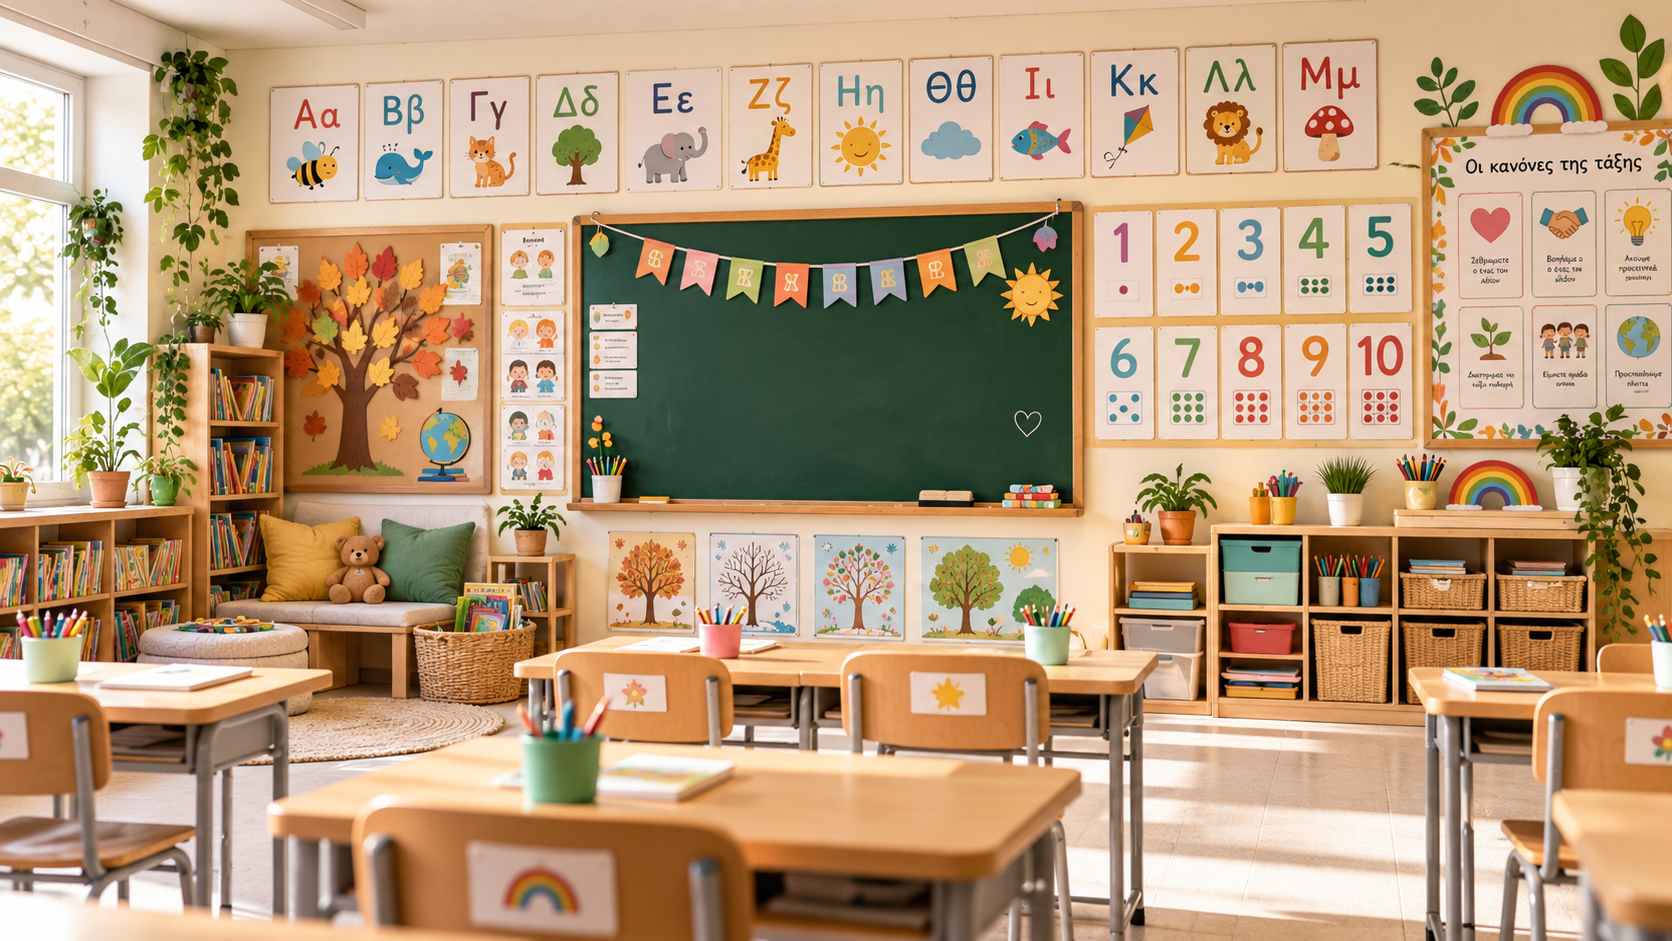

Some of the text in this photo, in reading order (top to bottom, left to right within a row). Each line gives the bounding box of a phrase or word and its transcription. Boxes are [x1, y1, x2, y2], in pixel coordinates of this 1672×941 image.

[838, 75, 884, 113] Ηη
[926, 69, 976, 103] Θθ
[1025, 67, 1055, 99] Ιι
[1111, 64, 1158, 97] Κκ
[1203, 58, 1256, 93] Λλ
[1301, 56, 1360, 100] Μμ
[294, 99, 340, 129] Αα
[384, 94, 424, 134] Ββ
[471, 91, 507, 130] Γγ
[553, 85, 599, 118] Δδ
[653, 83, 693, 114] Εε
[748, 77, 791, 115] Ζζ
[1466, 153, 1642, 175] Οι κανόνες της τάξης
[1114, 223, 1128, 263] 1
[1174, 221, 1200, 261] 2
[1238, 219, 1263, 261] 3
[1299, 218, 1329, 259] 4
[1367, 216, 1393, 258] 5
[1111, 338, 1137, 378] 6
[1175, 338, 1201, 378] 7
[1238, 337, 1264, 377] 8
[1302, 336, 1329, 377] 9
[1358, 335, 1403, 376] 10
